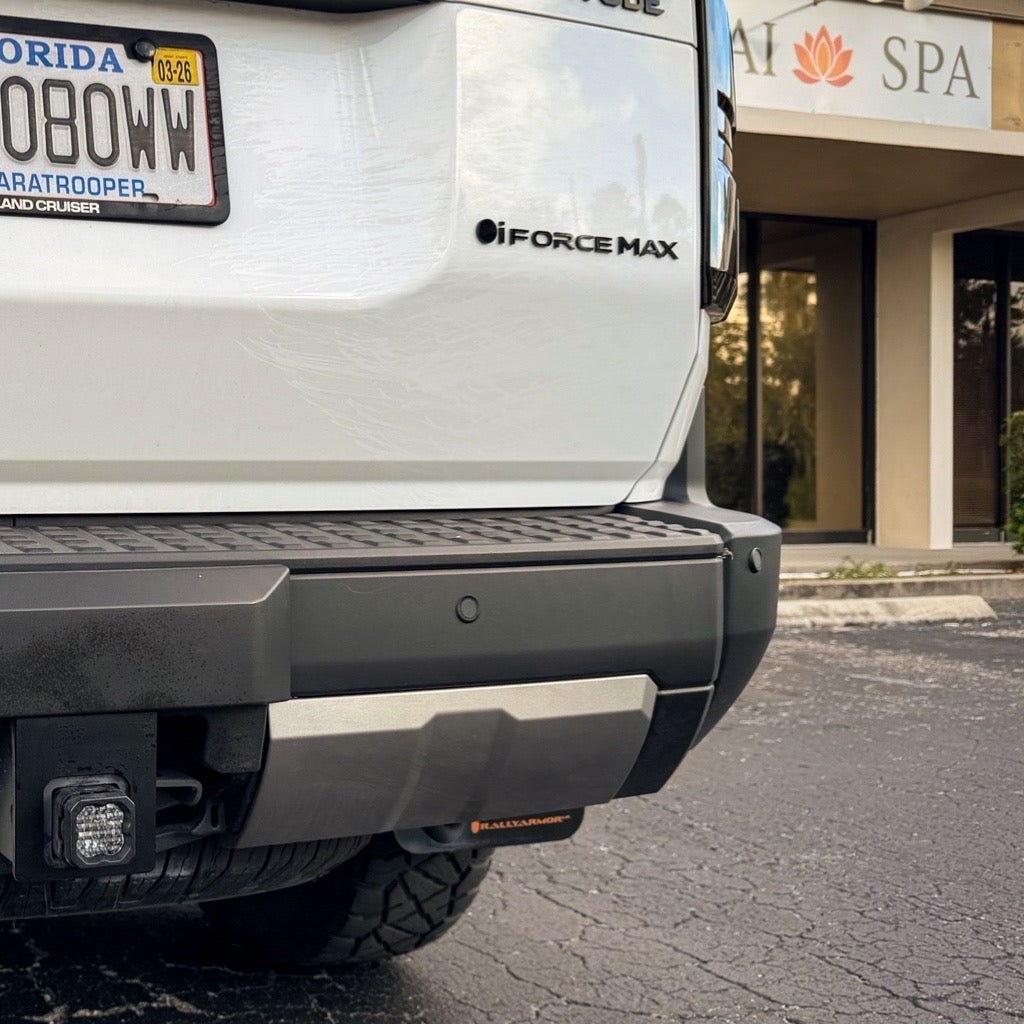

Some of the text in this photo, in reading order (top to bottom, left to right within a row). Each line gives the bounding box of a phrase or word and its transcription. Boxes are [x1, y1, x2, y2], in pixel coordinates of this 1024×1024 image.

[158, 59, 192, 83] 03-26
[883, 36, 980, 99] SPA
[36, 200, 100, 214] CRUISER
[617, 236, 679, 260] MAX
